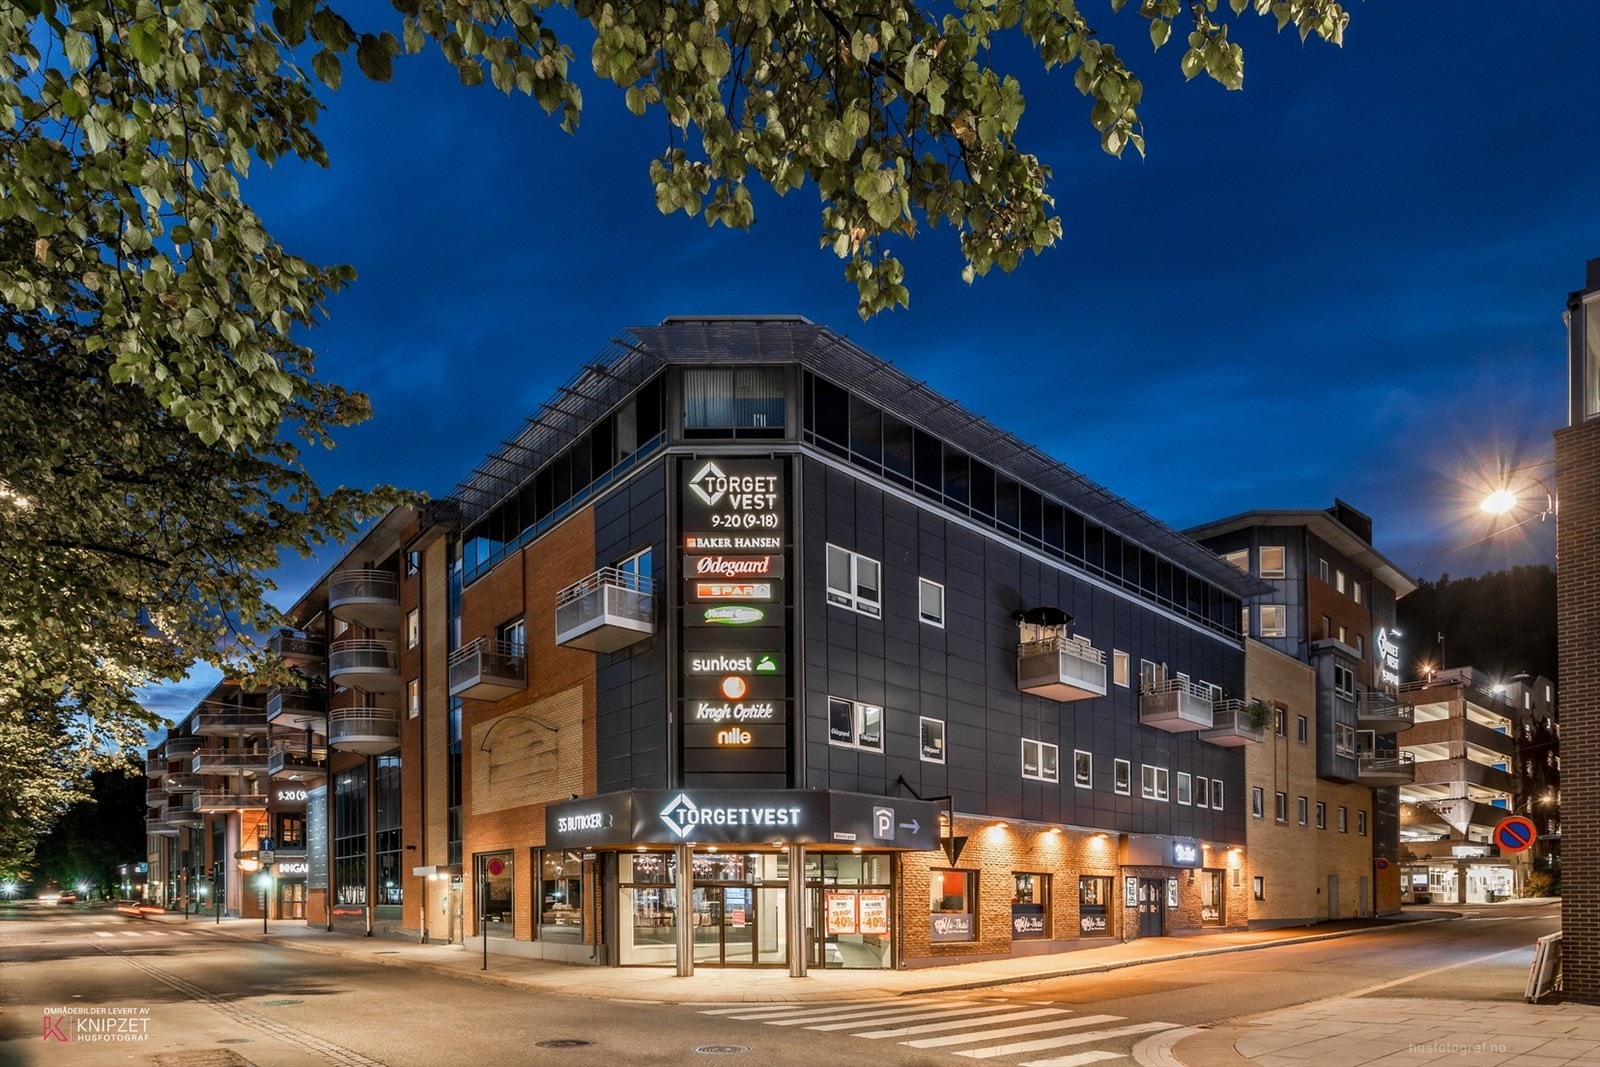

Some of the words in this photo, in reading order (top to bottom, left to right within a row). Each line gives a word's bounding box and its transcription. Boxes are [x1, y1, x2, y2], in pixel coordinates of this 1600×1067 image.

[705, 476, 777, 493] TORGET
[729, 494, 777, 510] VEST
[712, 515, 741, 527] 9-20
[743, 513, 778, 529] (9-18)
[697, 538, 732, 548] BAKER
[734, 538, 781, 548] HANSEN
[697, 556, 770, 577] Ødegaard
[711, 586, 754, 596] SPAR
[692, 656, 752, 671] sunkost
[697, 703, 731, 722] Krogh
[733, 703, 773, 722] Optikk
[718, 727, 751, 744] nille
[278, 791, 296, 801] 9-20
[830, 916, 855, 928] -40%
[861, 916, 887, 928] -40%
